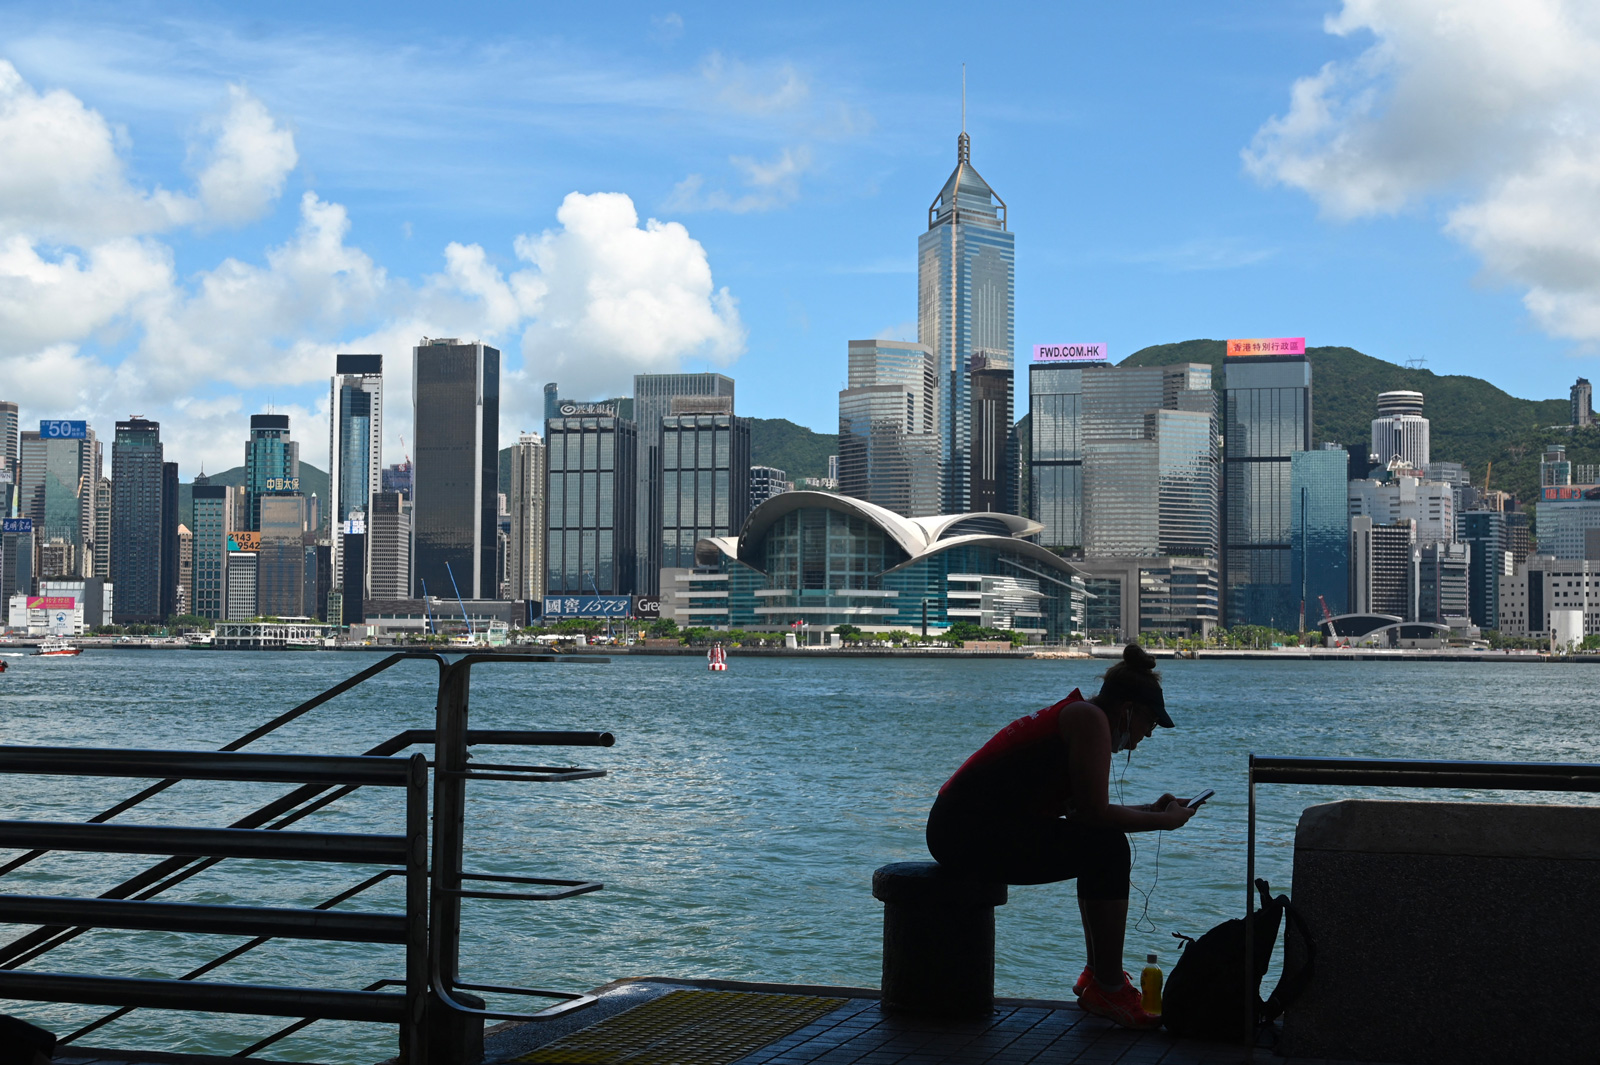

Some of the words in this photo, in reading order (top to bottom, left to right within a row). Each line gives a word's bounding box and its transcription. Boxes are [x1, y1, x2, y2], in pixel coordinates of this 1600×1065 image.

[1039, 345, 1100, 358] FWD.COM.HK
[1233, 341, 1299, 352] 香港特別行政區
[48, 421, 72, 437] 50
[266, 477, 300, 490] 中国太保
[3, 520, 31, 531] 光明食品
[228, 533, 252, 541] 2143
[237, 541, 260, 550] 9542
